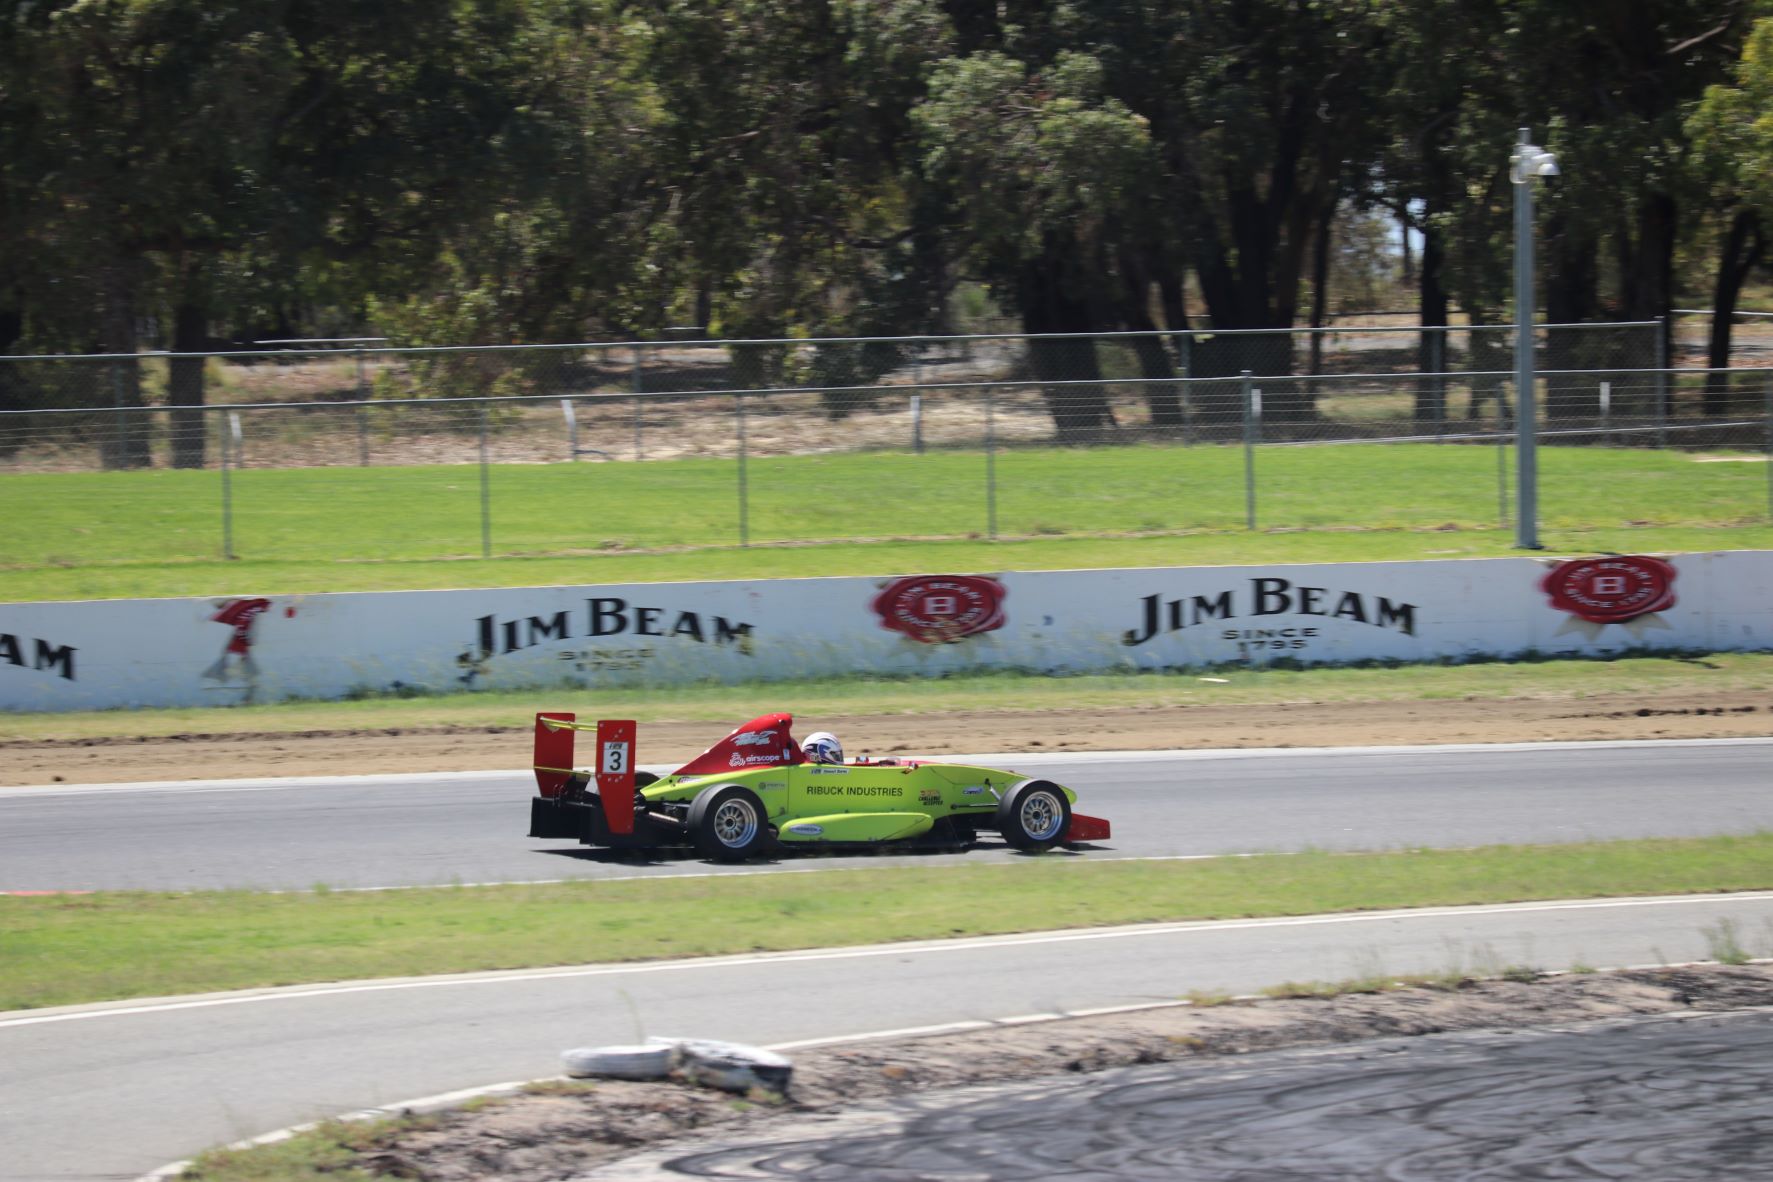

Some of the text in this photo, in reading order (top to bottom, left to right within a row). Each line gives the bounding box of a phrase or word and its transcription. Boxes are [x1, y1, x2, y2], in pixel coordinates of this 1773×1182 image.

[1122, 578, 1419, 646] JIM BEAM
[456, 597, 756, 667] JIM BEAM
[1223, 627, 1319, 640] SINCE
[1238, 639, 1308, 650] 1795
[559, 649, 656, 662] SINCE
[609, 750, 622, 771] 3
[746, 754, 780, 763] airscope
[806, 786, 903, 797] RIBUCK INDUSTRIES
